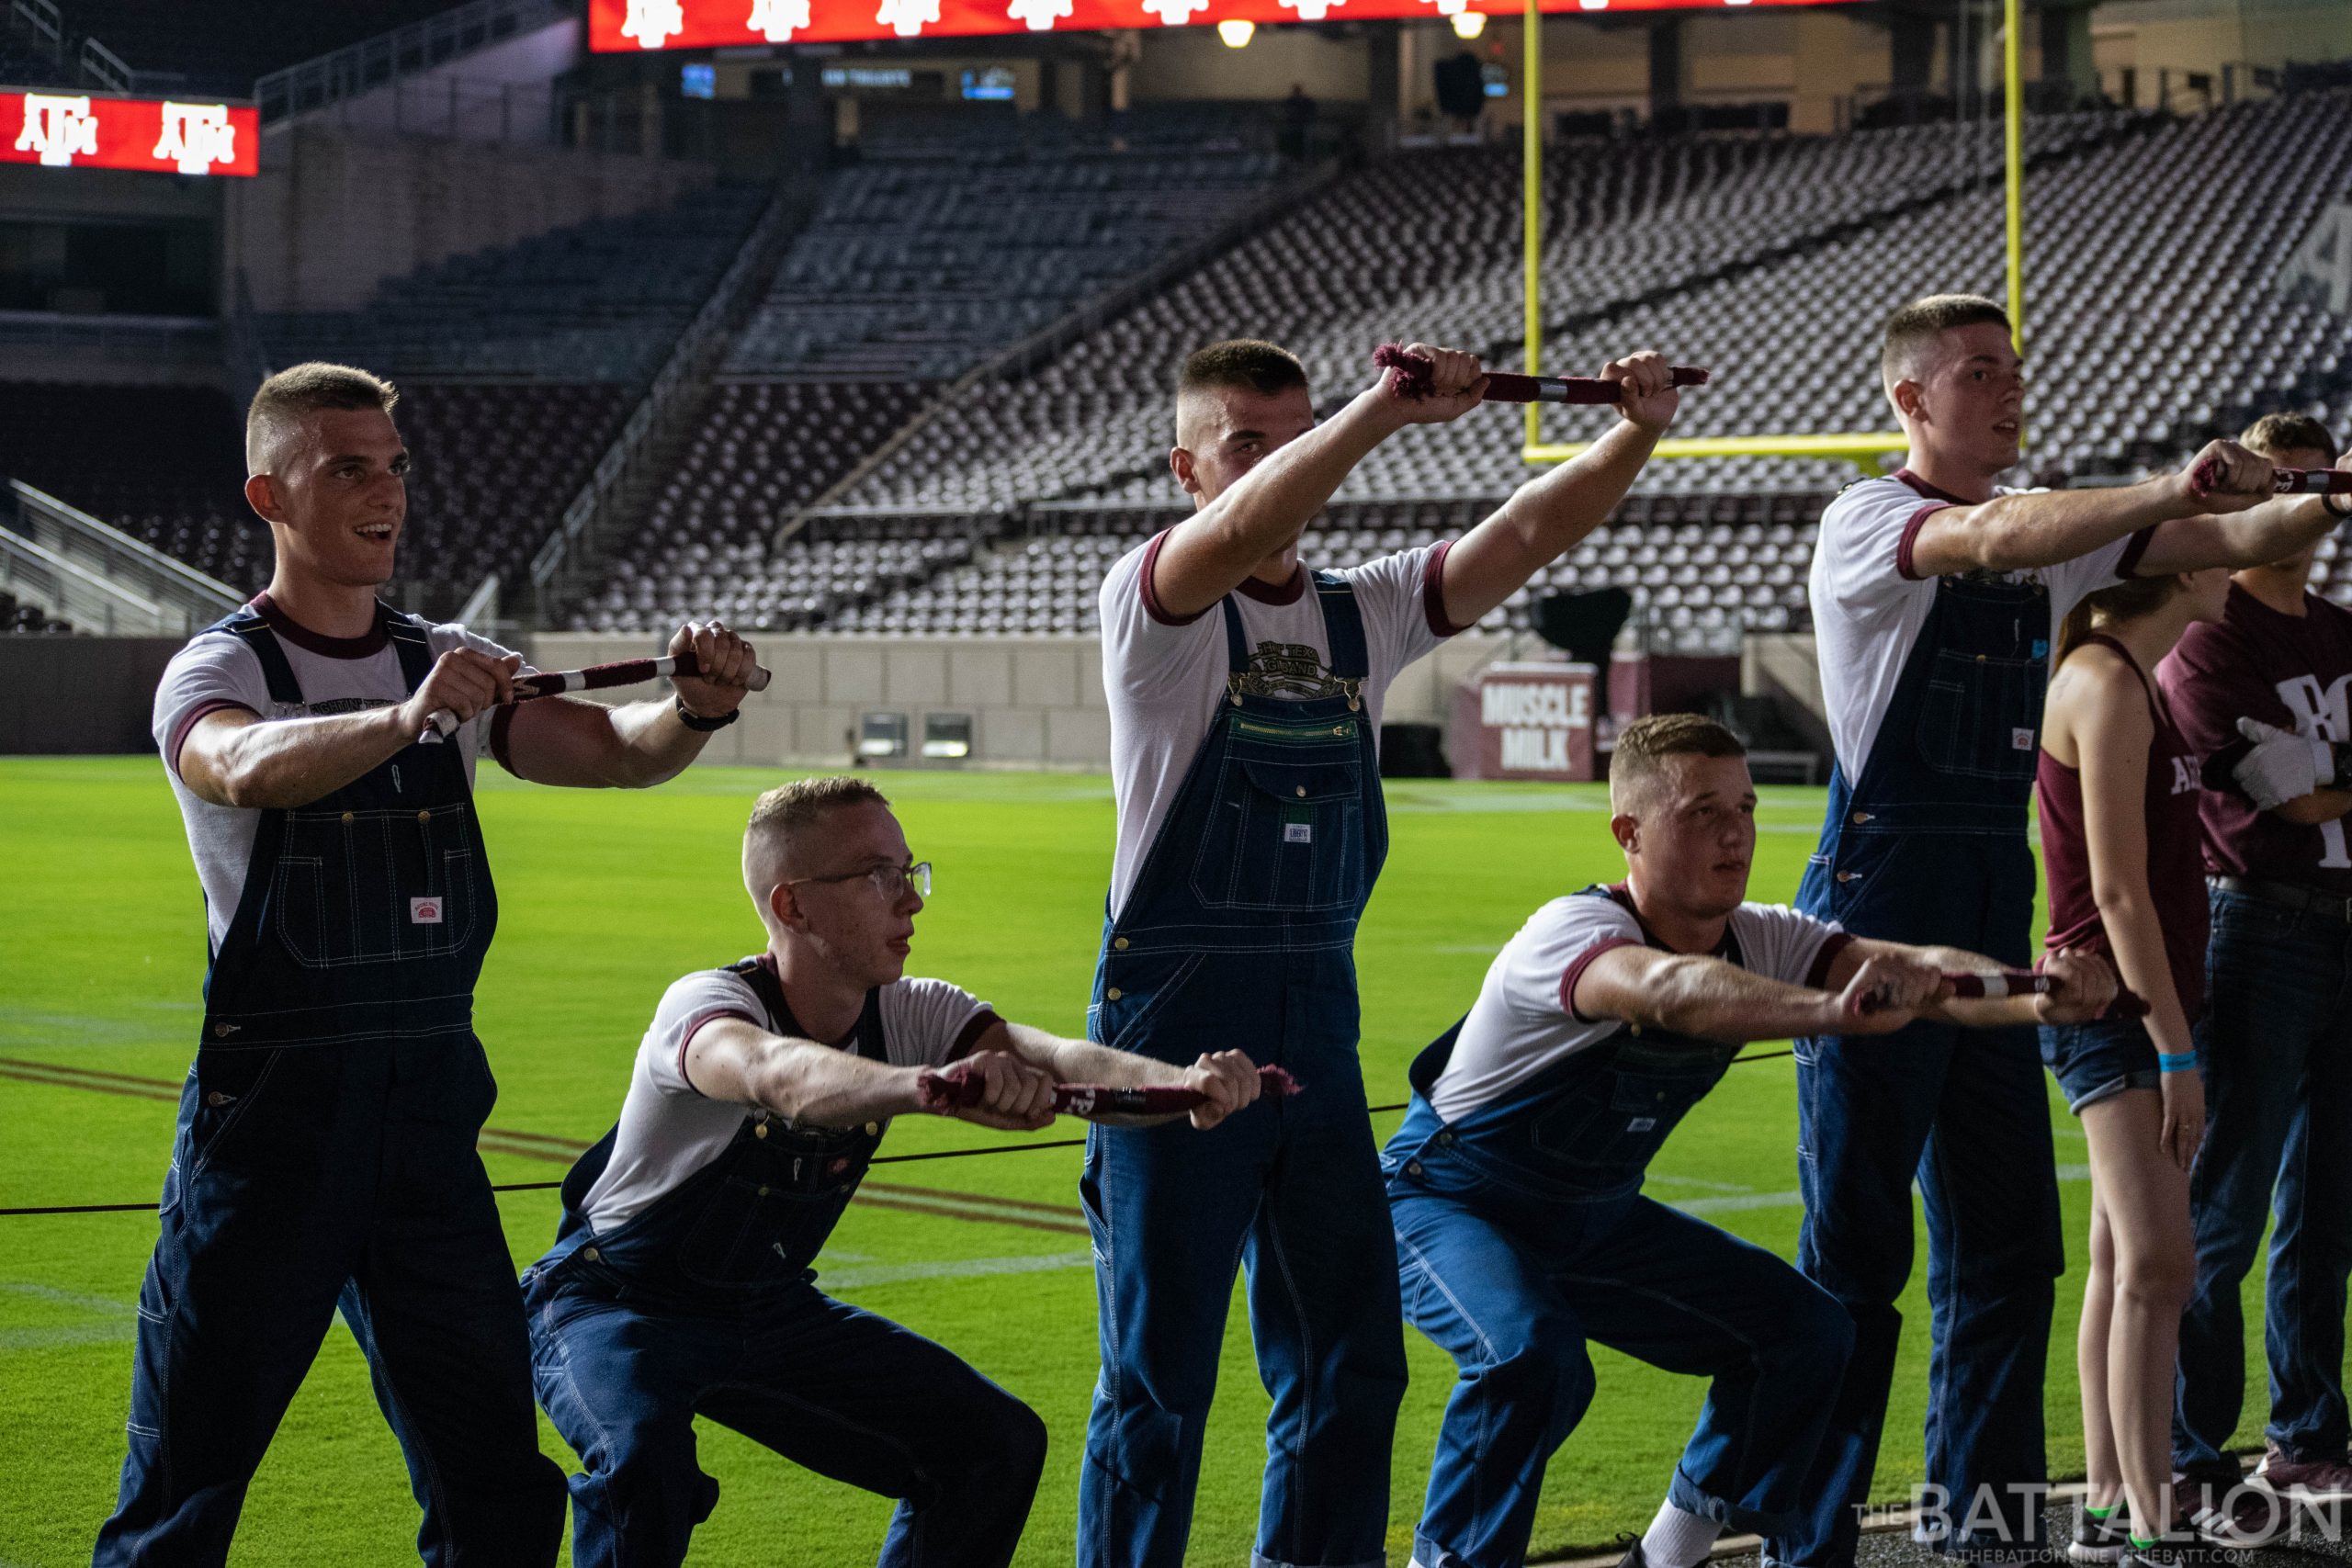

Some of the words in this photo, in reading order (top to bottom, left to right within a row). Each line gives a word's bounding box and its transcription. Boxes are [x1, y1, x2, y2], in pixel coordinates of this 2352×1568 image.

[1282, 662, 1317, 677] BAND
[1482, 683, 1590, 728] MUSCLE
[1501, 728, 1572, 771] MILK
